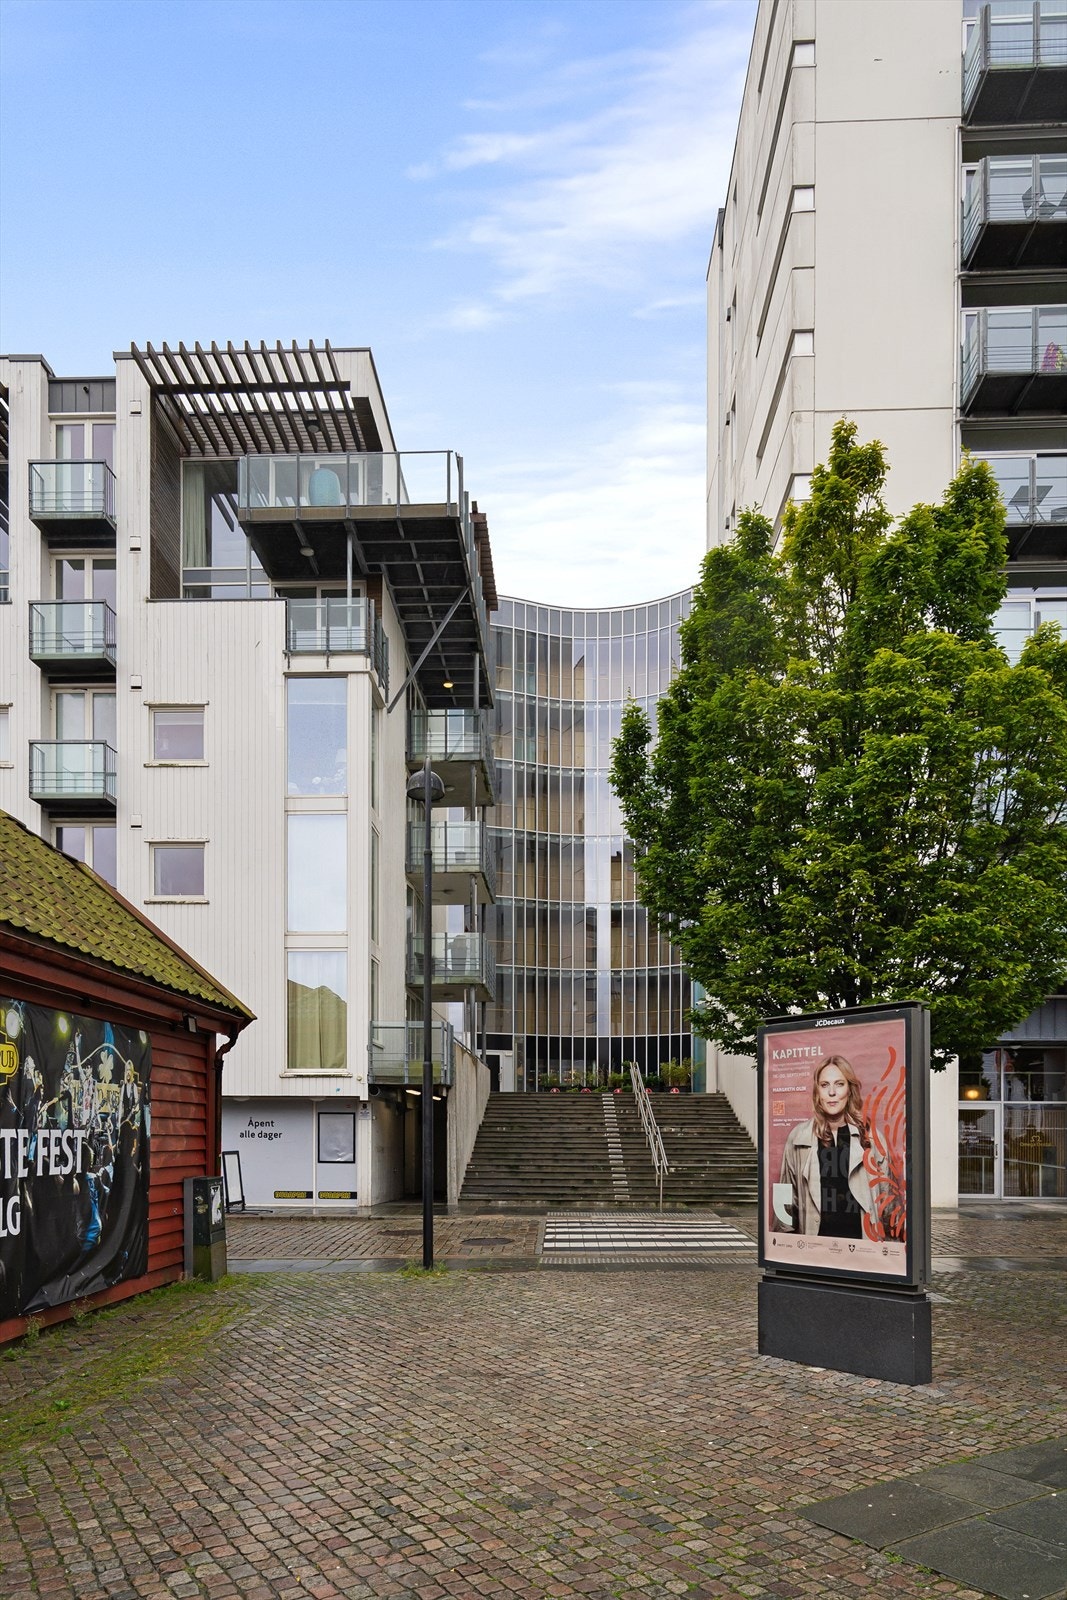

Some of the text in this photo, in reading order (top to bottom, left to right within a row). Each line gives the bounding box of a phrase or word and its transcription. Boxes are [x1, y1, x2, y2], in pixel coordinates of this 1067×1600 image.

[815, 1018, 845, 1027] JCDecaux
[772, 1046, 824, 1060] KAPITTEL
[247, 1116, 275, 1129] Åpent
[239, 1130, 283, 1141] alle dager
[36, 1129, 86, 1177] FEST
